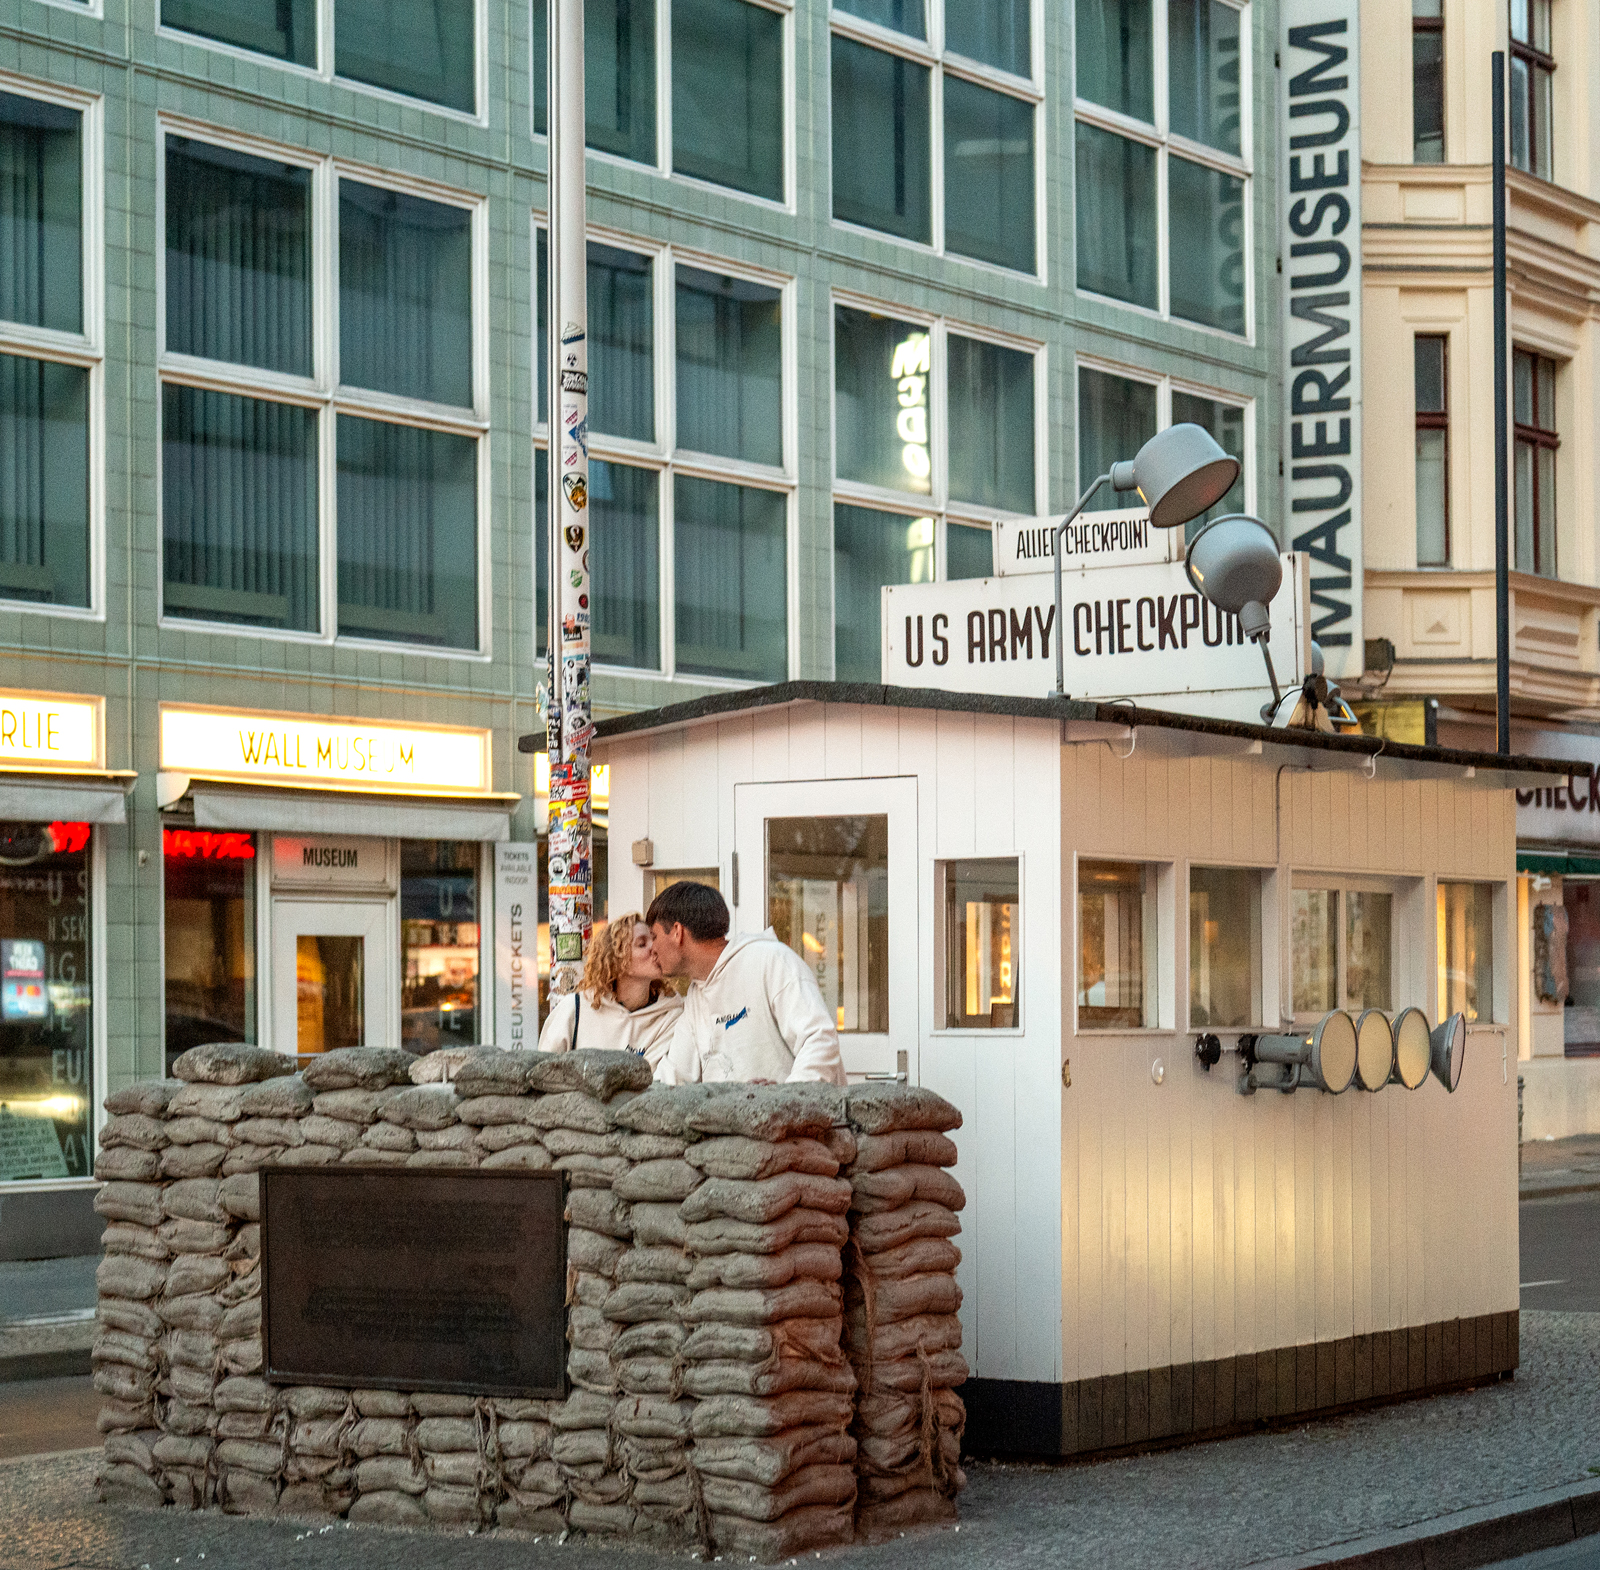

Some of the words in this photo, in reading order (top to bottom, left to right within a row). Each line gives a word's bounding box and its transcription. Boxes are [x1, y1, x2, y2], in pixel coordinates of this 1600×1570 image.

[1288, 18, 1352, 648] MAUERMUSEUM
[1065, 518, 1150, 555] CHECKPOINT
[967, 604, 1056, 664] ARMY
[1073, 592, 1270, 656] CHECKPOI
[238, 730, 308, 769] WALL
[316, 735, 414, 774] MUSEUM
[302, 846, 358, 868] MUSEUM
